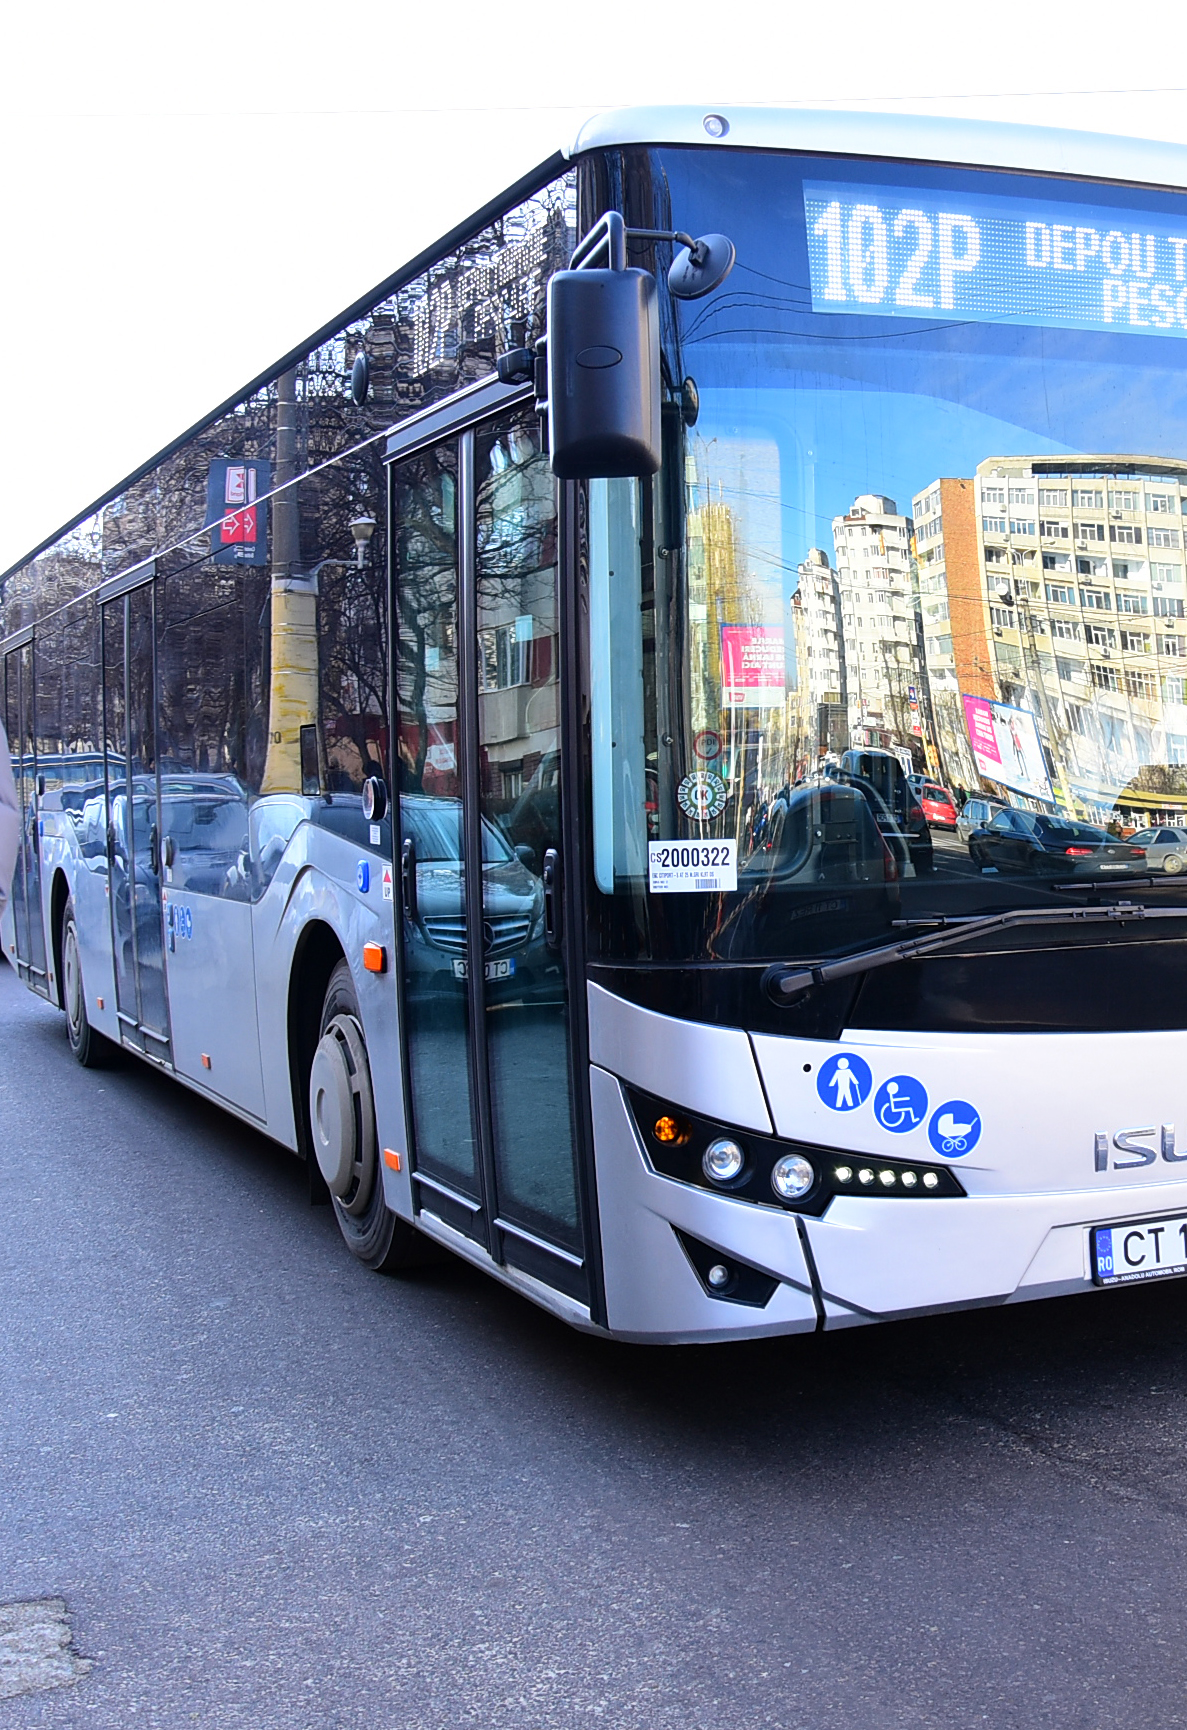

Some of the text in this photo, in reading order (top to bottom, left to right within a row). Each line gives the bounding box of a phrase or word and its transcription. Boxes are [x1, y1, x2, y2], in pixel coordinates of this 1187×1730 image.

[812, 201, 981, 311] 102P
[1026, 221, 1158, 278] DEPOU
[1098, 1255, 1113, 1273] RO
[1123, 1226, 1166, 1267] CT
